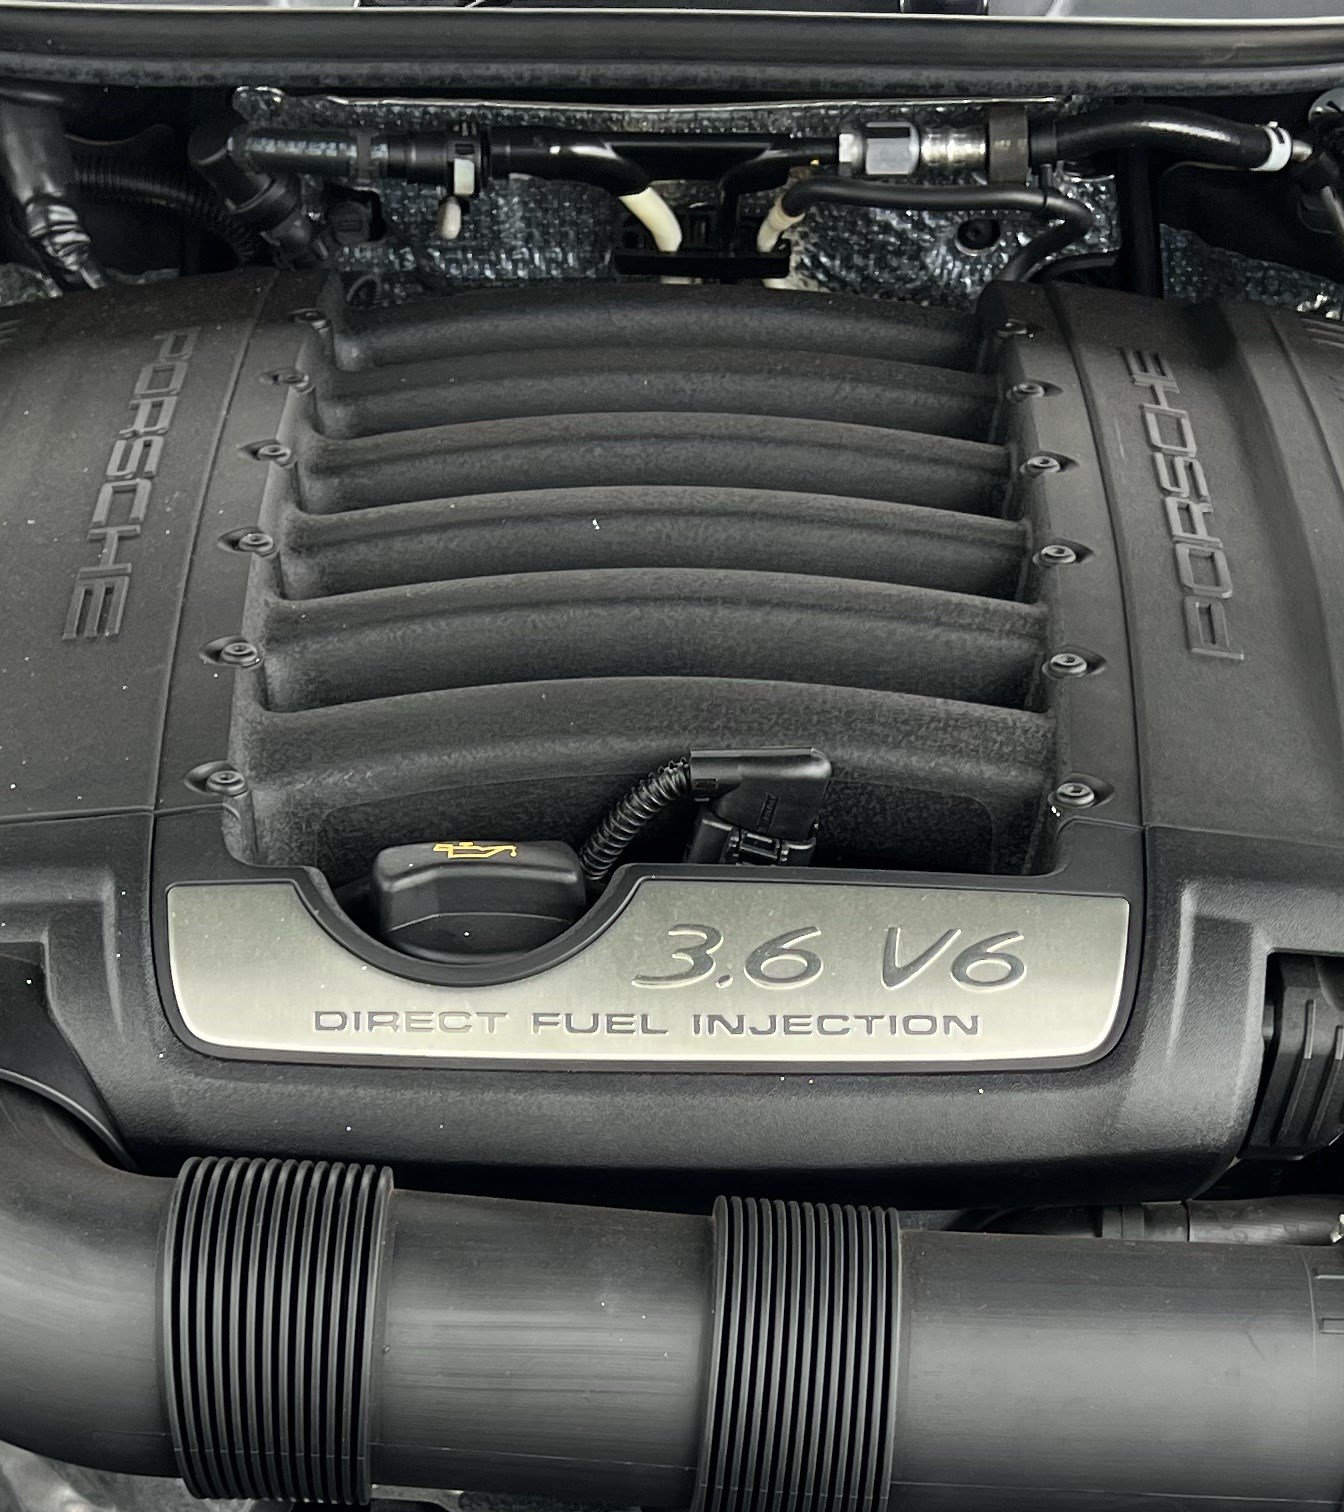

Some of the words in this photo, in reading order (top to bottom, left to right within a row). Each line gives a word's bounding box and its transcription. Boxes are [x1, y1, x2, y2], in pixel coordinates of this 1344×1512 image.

[62, 329, 202, 642] PORSCHE
[1120, 347, 1245, 661] PORSCHE
[313, 1009, 509, 1035] DIRECT
[532, 1010, 669, 1036] FUEL
[691, 1011, 981, 1038] INJECTION
[632, 923, 823, 992] 3.6
[878, 925, 1029, 994] V6
